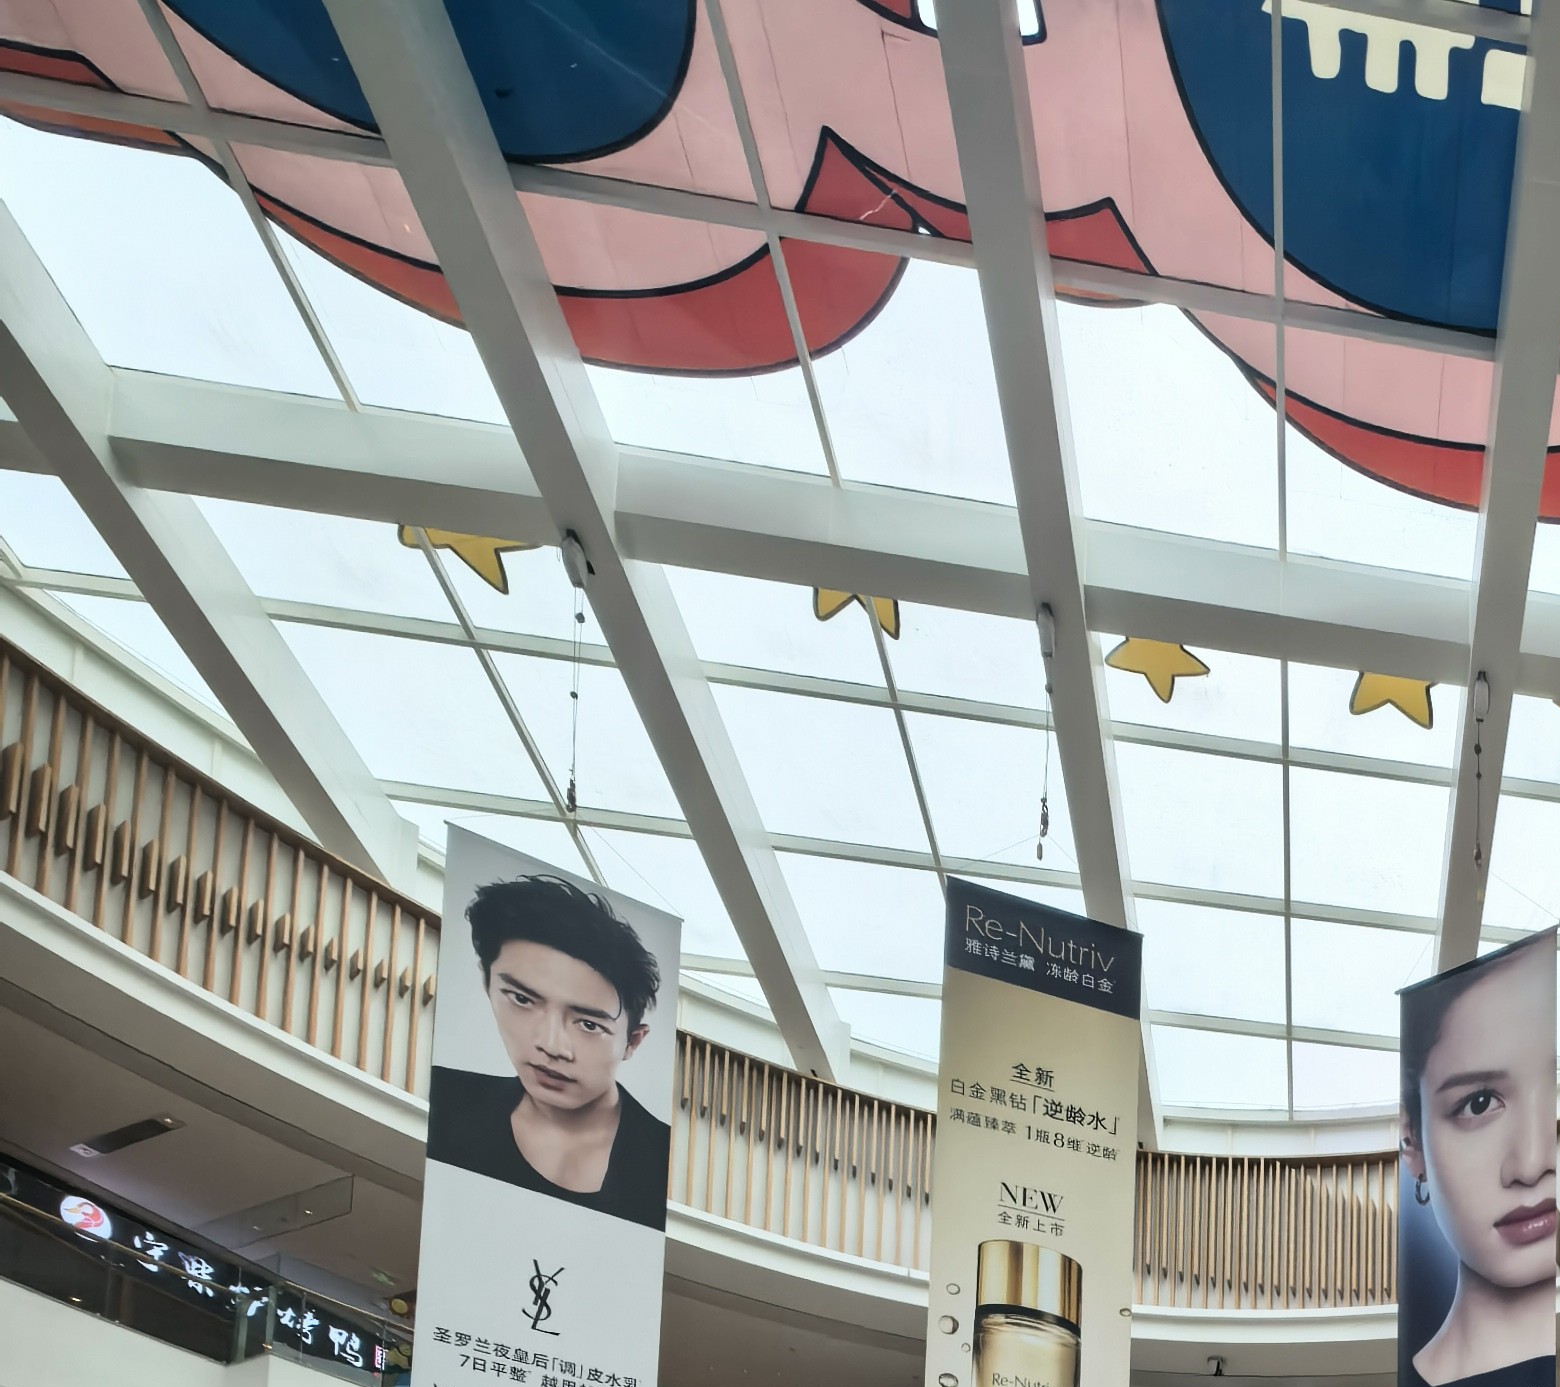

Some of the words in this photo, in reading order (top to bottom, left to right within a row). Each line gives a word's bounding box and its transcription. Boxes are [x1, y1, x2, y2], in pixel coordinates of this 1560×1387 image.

[965, 904, 1115, 972] Re-Nutriv
[964, 937, 1035, 971] 雅诗兰黛
[1046, 961, 1113, 994] 冻龄白金
[1011, 1062, 1055, 1088] 全新
[1000, 1181, 1064, 1215] NEW
[997, 1211, 1065, 1237] 全新上市
